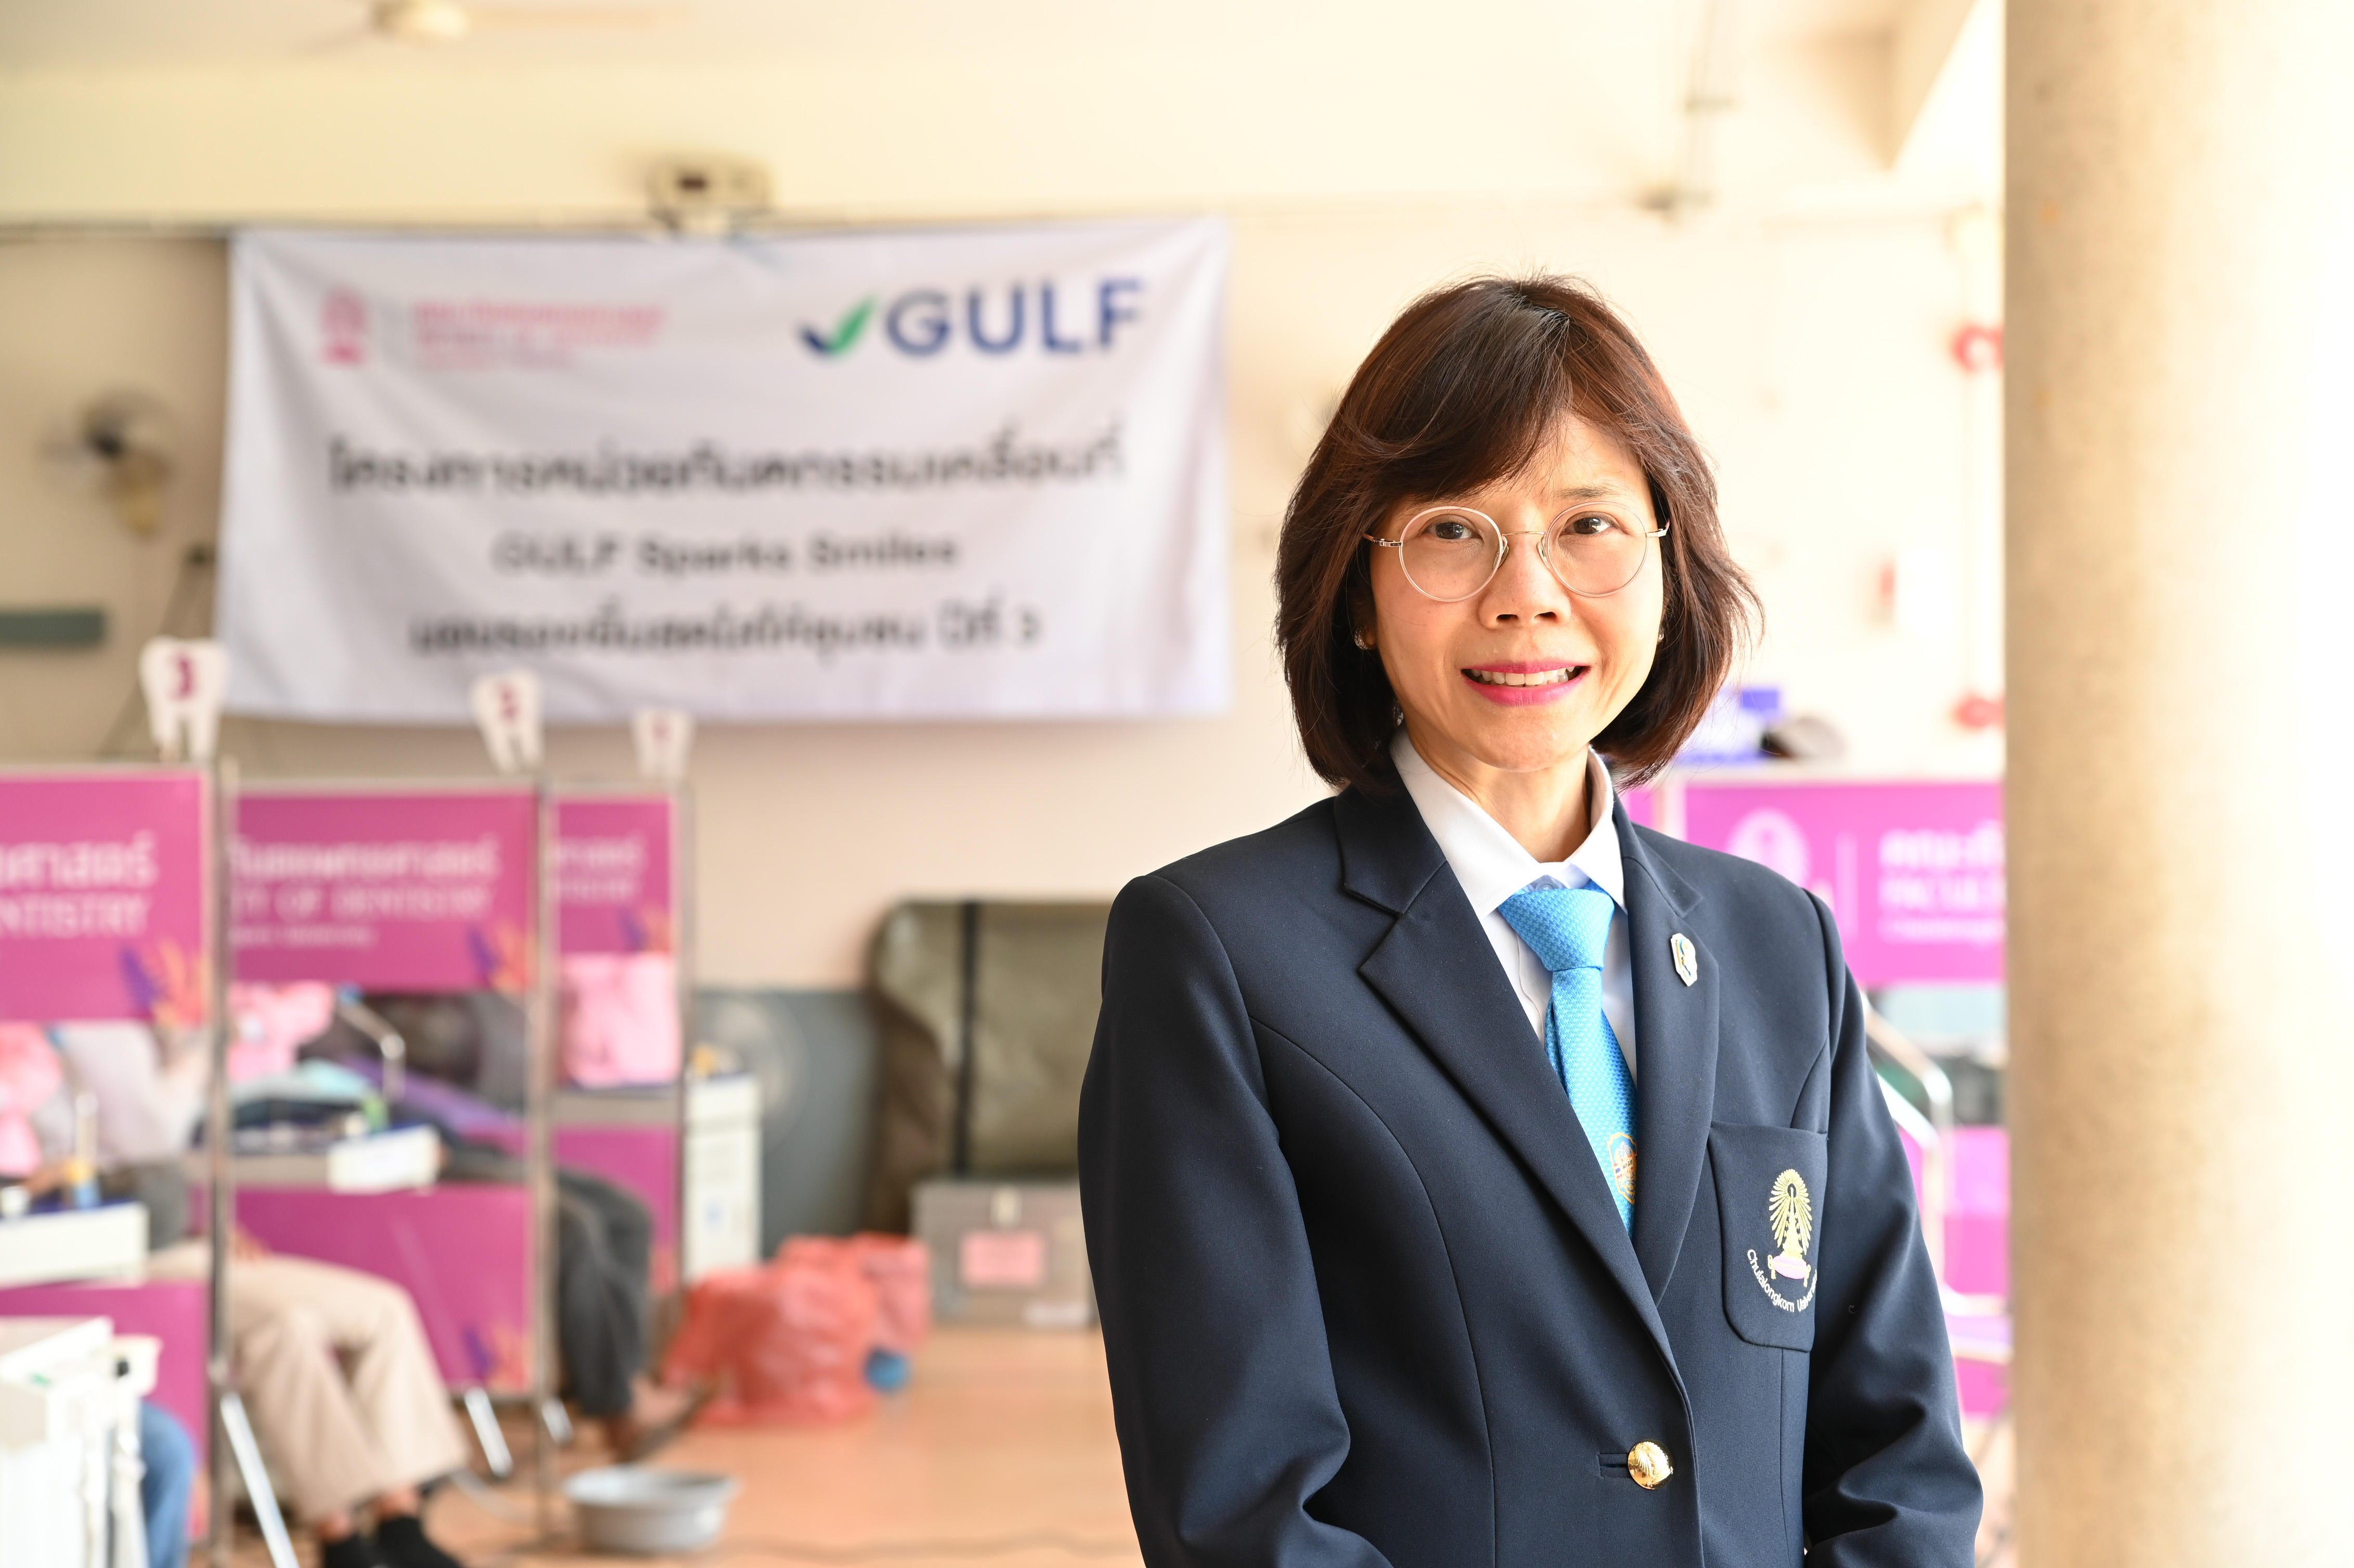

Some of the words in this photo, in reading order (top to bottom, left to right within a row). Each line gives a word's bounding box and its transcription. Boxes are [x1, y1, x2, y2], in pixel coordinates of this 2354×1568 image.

[886, 279, 1145, 358] GULF
[491, 530, 620, 574] GULF
[636, 530, 791, 580] Sparks
[807, 529, 960, 571] Smiles
